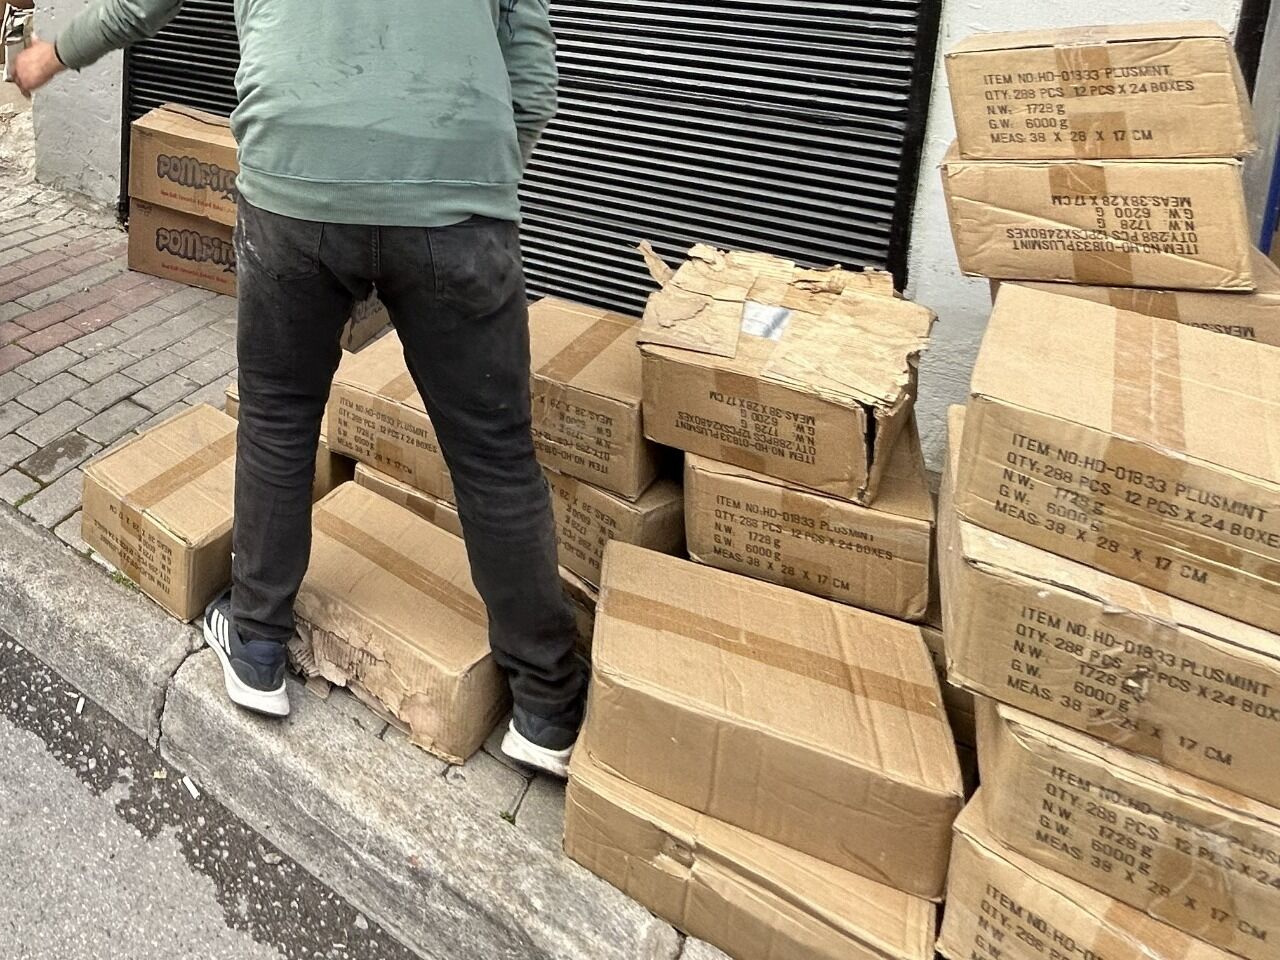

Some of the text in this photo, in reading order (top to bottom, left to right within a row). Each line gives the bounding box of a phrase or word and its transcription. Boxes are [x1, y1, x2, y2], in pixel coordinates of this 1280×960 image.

[983, 73, 1012, 85] ITEM
[1104, 64, 1171, 79] PLUSMINT
[1012, 88, 1035, 100] 288
[1039, 86, 1064, 98] PCS
[1073, 86, 1086, 97] 12
[1089, 83, 1115, 96] PCS
[1117, 84, 1126, 94] X
[1129, 82, 1147, 93] 24
[1150, 77, 1194, 92] BOXES
[1026, 103, 1065, 115] 1728 g
[1025, 117, 1069, 129] 6000 g
[1029, 132, 1045, 142] 38
[1053, 131, 1061, 141] X
[1069, 130, 1086, 141] 28
[1094, 130, 1104, 141] X
[1112, 130, 1125, 140] 17
[1131, 129, 1153, 140] CM
[1095, 206, 1150, 218] 6200 G
[1096, 218, 1151, 229] 1728 G
[1162, 242, 1198, 254] ITEM
[789, 449, 815, 465] ITEM
[1011, 433, 1050, 456] ITEM
[1174, 483, 1268, 524] PLUSMINT
[716, 495, 740, 509] ITEM
[1006, 451, 1041, 472] QTY:
[1042, 464, 1073, 483] 288
[1078, 473, 1111, 496] PCS
[1124, 488, 1142, 505] 12
[1146, 494, 1179, 517] PCS
[1184, 506, 1196, 522] X
[1200, 511, 1224, 531] 24
[1054, 486, 1090, 507] 1728
[739, 515, 758, 528] 288
[762, 521, 782, 534] PCS
[1045, 501, 1087, 525] 6000
[748, 530, 770, 545] 1728
[745, 543, 771, 558] 6000
[1045, 518, 1066, 535] 38
[1075, 528, 1087, 542] X
[1095, 535, 1119, 553] 28
[1130, 547, 1142, 561] X
[1154, 555, 1172, 572] 17
[1179, 563, 1208, 584] CM
[832, 577, 849, 591] CM
[1020, 605, 1061, 630] ITEM
[1180, 656, 1271, 699] PLUSMINT
[1054, 636, 1084, 657] 288
[1089, 648, 1122, 670] PCS
[1157, 669, 1191, 693] PCS
[1197, 682, 1207, 699] X
[1211, 686, 1235, 708] 24
[1079, 663, 1117, 687] 1728
[1072, 679, 1116, 706] 6000
[1059, 694, 1082, 712] 38
[1150, 726, 1160, 740] X
[1178, 736, 1197, 752] 17
[1204, 745, 1232, 766] CM
[1086, 801, 1117, 824] 288
[1123, 816, 1158, 842] PCS
[1174, 836, 1192, 855] 12
[1098, 824, 1136, 851] 1728
[1091, 838, 1135, 867] 6000
[985, 883, 1024, 919] ITEM
[1090, 854, 1266, 942] 38 X 28 X 17 CM
